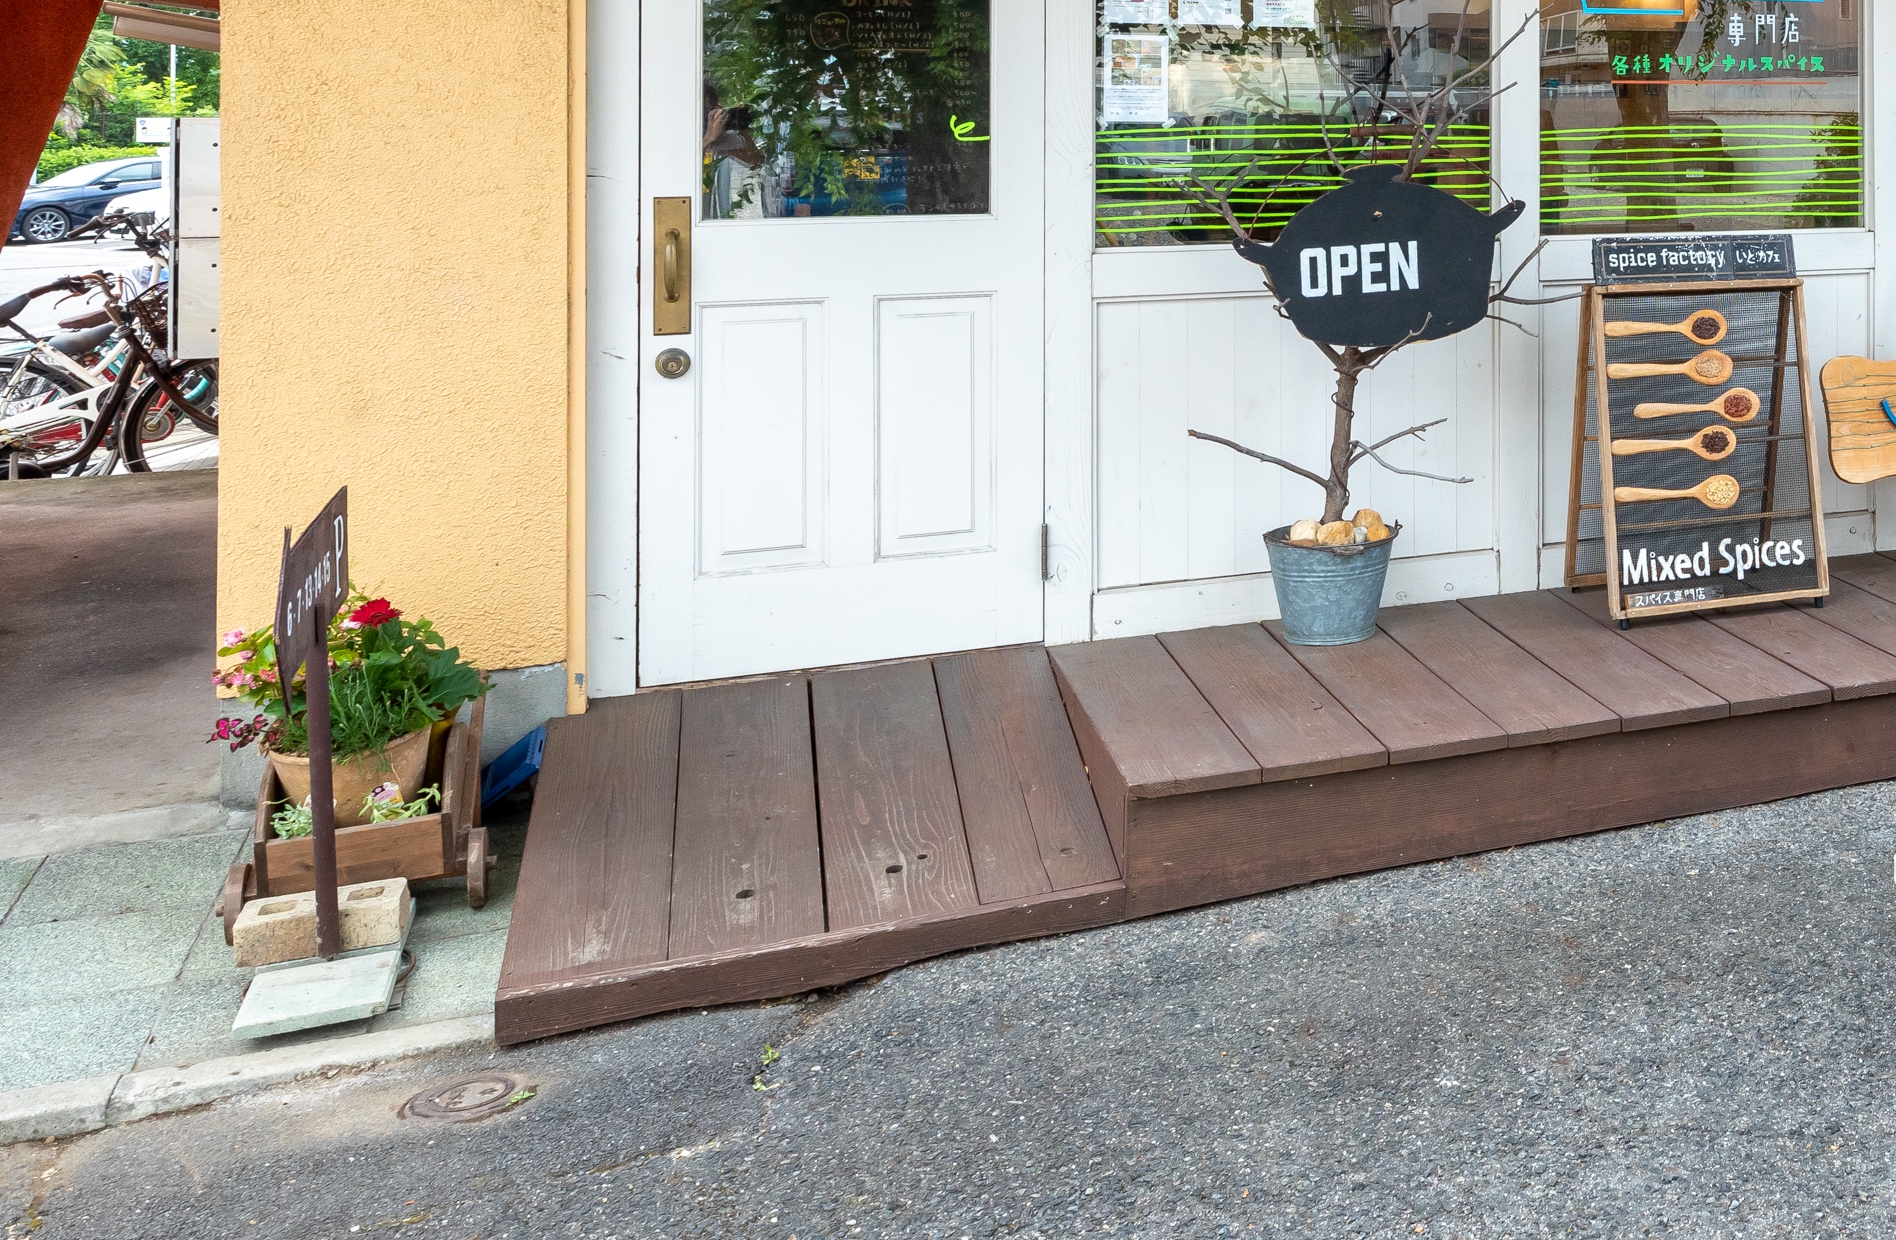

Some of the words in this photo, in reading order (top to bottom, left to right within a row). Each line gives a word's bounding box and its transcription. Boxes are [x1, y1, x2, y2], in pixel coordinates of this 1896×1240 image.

[1727, 12, 1800, 47] 専門店
[1299, 240, 1420, 298] OPEN
[1608, 248, 1657, 269] spice
[1660, 246, 1726, 269] factory
[1735, 247, 1781, 266] いとカフェ
[333, 514, 344, 599] P
[1622, 548, 1712, 587] Mixed
[1719, 537, 1806, 580] Spices
[1634, 587, 1706, 608] スパイス専門店
